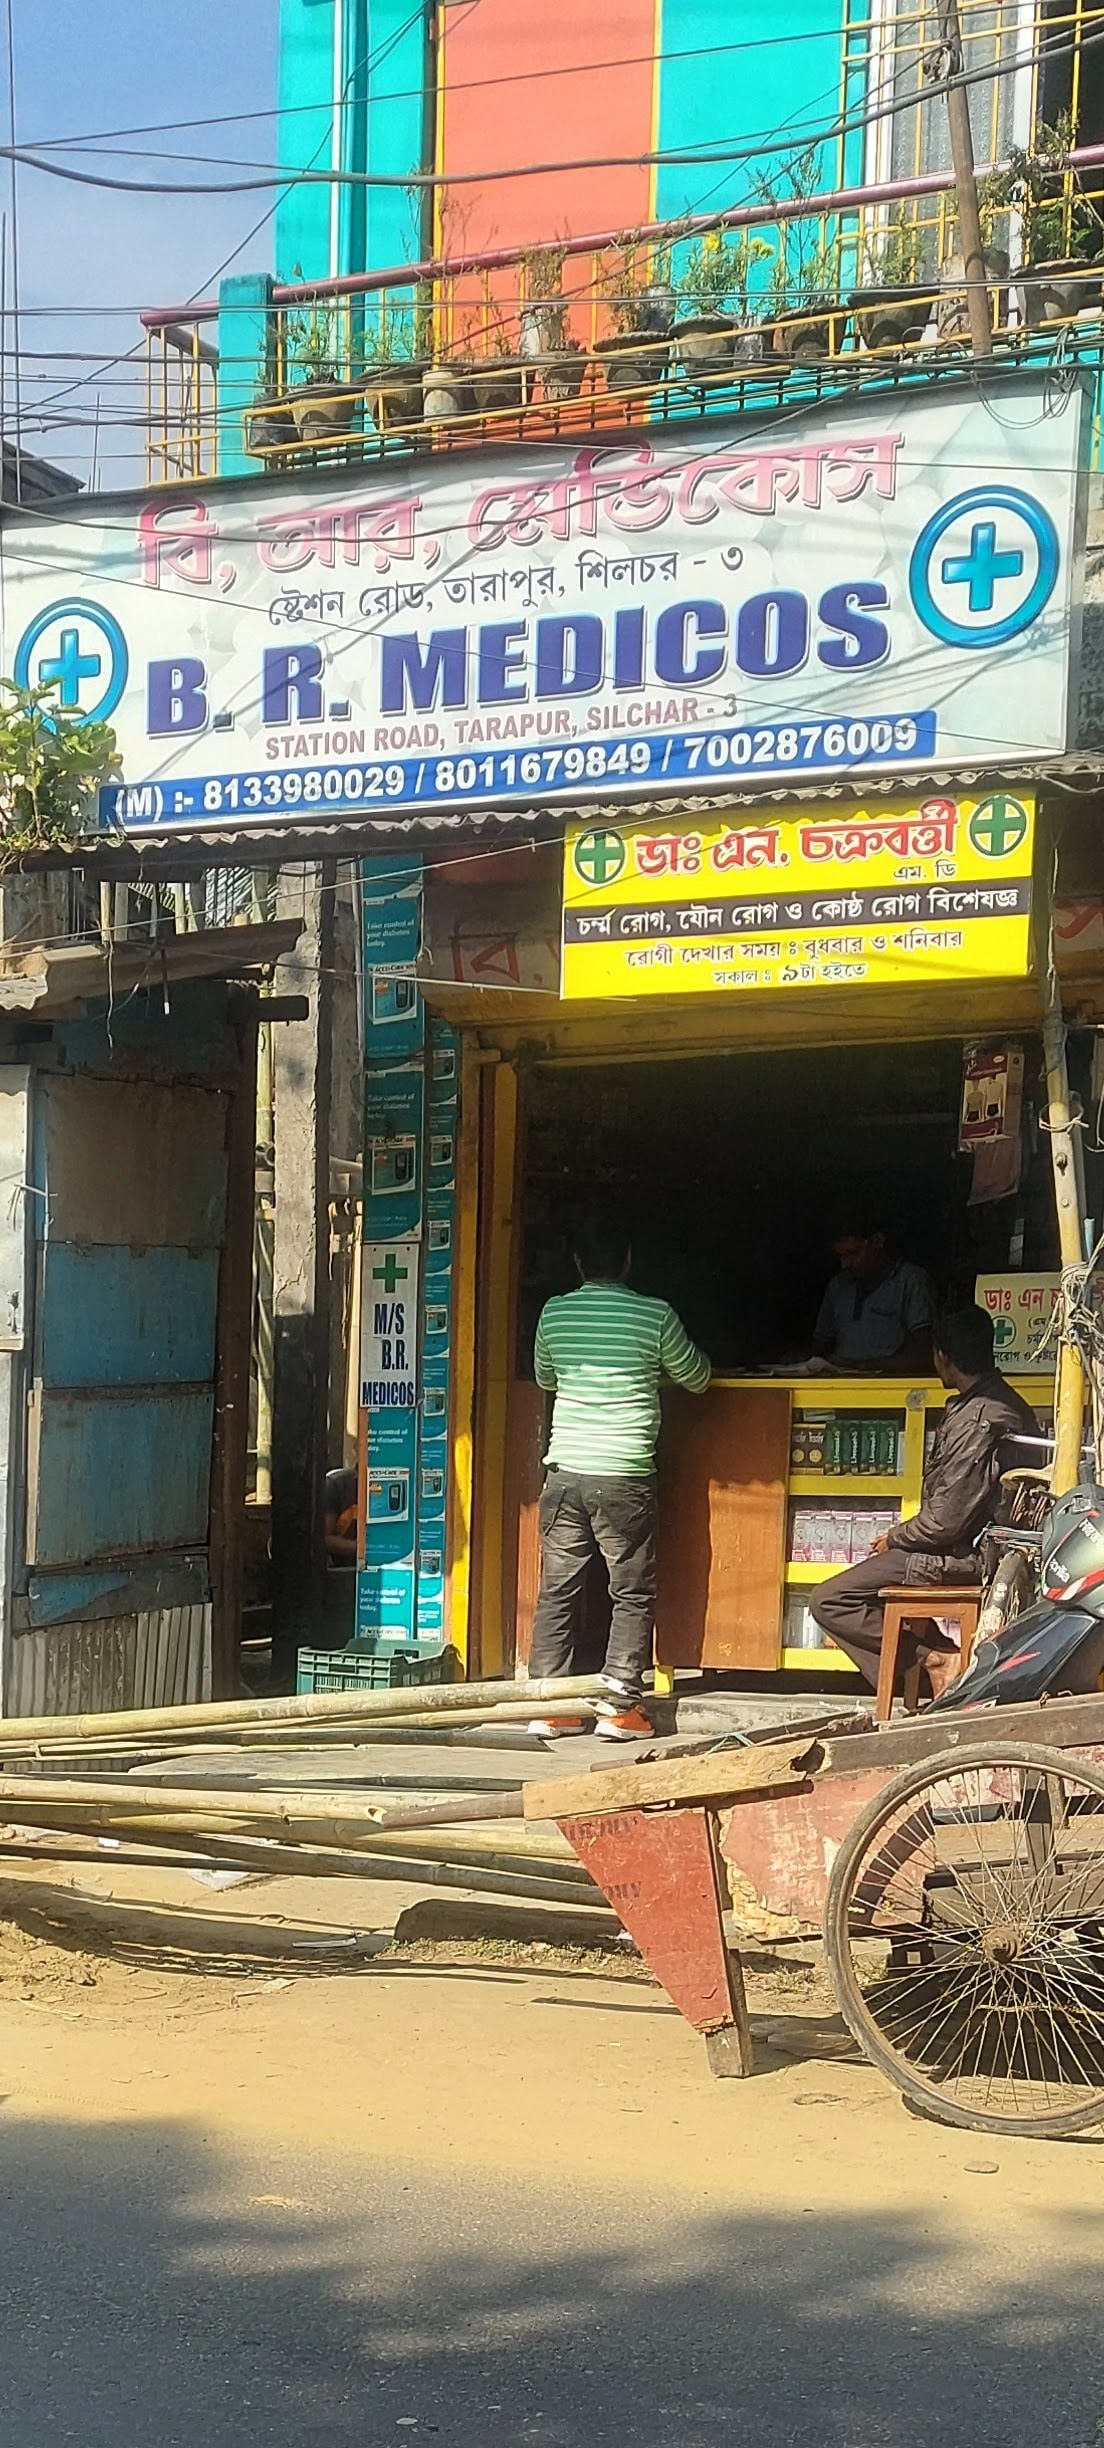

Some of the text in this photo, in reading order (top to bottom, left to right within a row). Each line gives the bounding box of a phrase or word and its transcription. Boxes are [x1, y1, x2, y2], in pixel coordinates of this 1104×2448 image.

[256, 495, 440, 575] আর,
[467, 433, 905, 550] মেডিকোস
[359, 582, 433, 616] রোড,
[442, 563, 565, 609] তারাপুর,
[575, 549, 679, 592] শিলচর
[721, 547, 744, 571] ৩
[146, 580, 893, 738] B. R. MEDICOS
[266, 728, 365, 761] STATION
[373, 722, 446, 753] ROAD,
[454, 707, 580, 744] TARAPUR,
[586, 698, 698, 732] SILCHAR
[723, 693, 738, 718] 3
[115, 785, 163, 824] (M)
[203, 767, 404, 812] 8133980029
[413, 763, 426, 791] /
[434, 743, 651, 790] 8011679849
[661, 743, 673, 771] /
[685, 717, 918, 770] 7002876009
[636, 835, 701, 874] ডাঃ
[620, 910, 671, 934] রোগ,
[677, 902, 723, 929] যৌন
[732, 901, 779, 926] রোগ
[785, 902, 803, 920] ও
[811, 891, 864, 921] কোষ্ঠ
[871, 892, 921, 917] রোগ
[625, 944, 672, 966] রোগী
[681, 944, 733, 963] দেখার
[741, 941, 780, 957] সময়
[803, 936, 863, 960] বুধবার
[871, 936, 886, 950] ও
[893, 927, 963, 950] শনিবার
[714, 970, 758, 985] সকাল
[821, 962, 867, 978] হইতে
[374, 1303, 405, 1335] M/S
[382, 1339, 409, 1370] B.R.
[362, 1381, 415, 1405] MEDICOS
